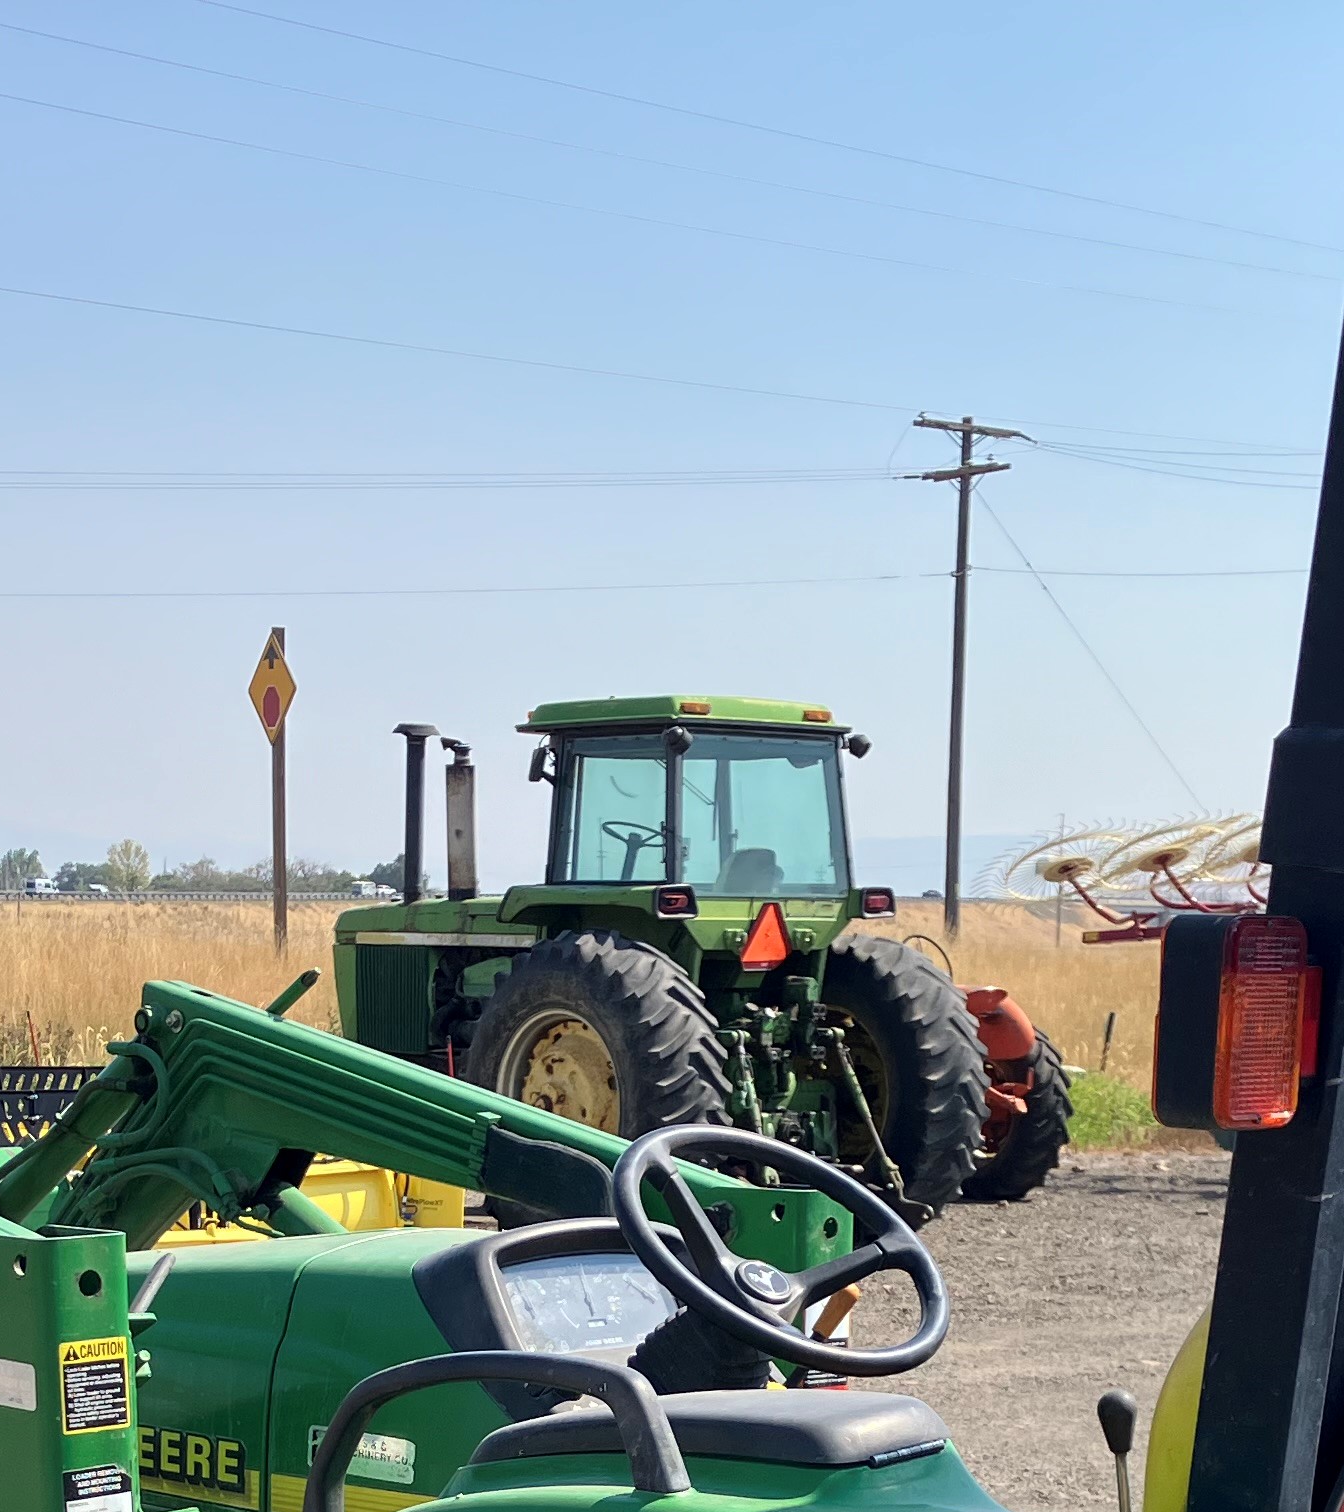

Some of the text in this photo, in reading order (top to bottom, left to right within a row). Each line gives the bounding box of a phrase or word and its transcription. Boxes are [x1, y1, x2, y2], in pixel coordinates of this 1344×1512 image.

[79, 1341, 124, 1358] CAUTION
[138, 1426, 241, 1485] EERE
[71, 1470, 97, 1481] LOADER
